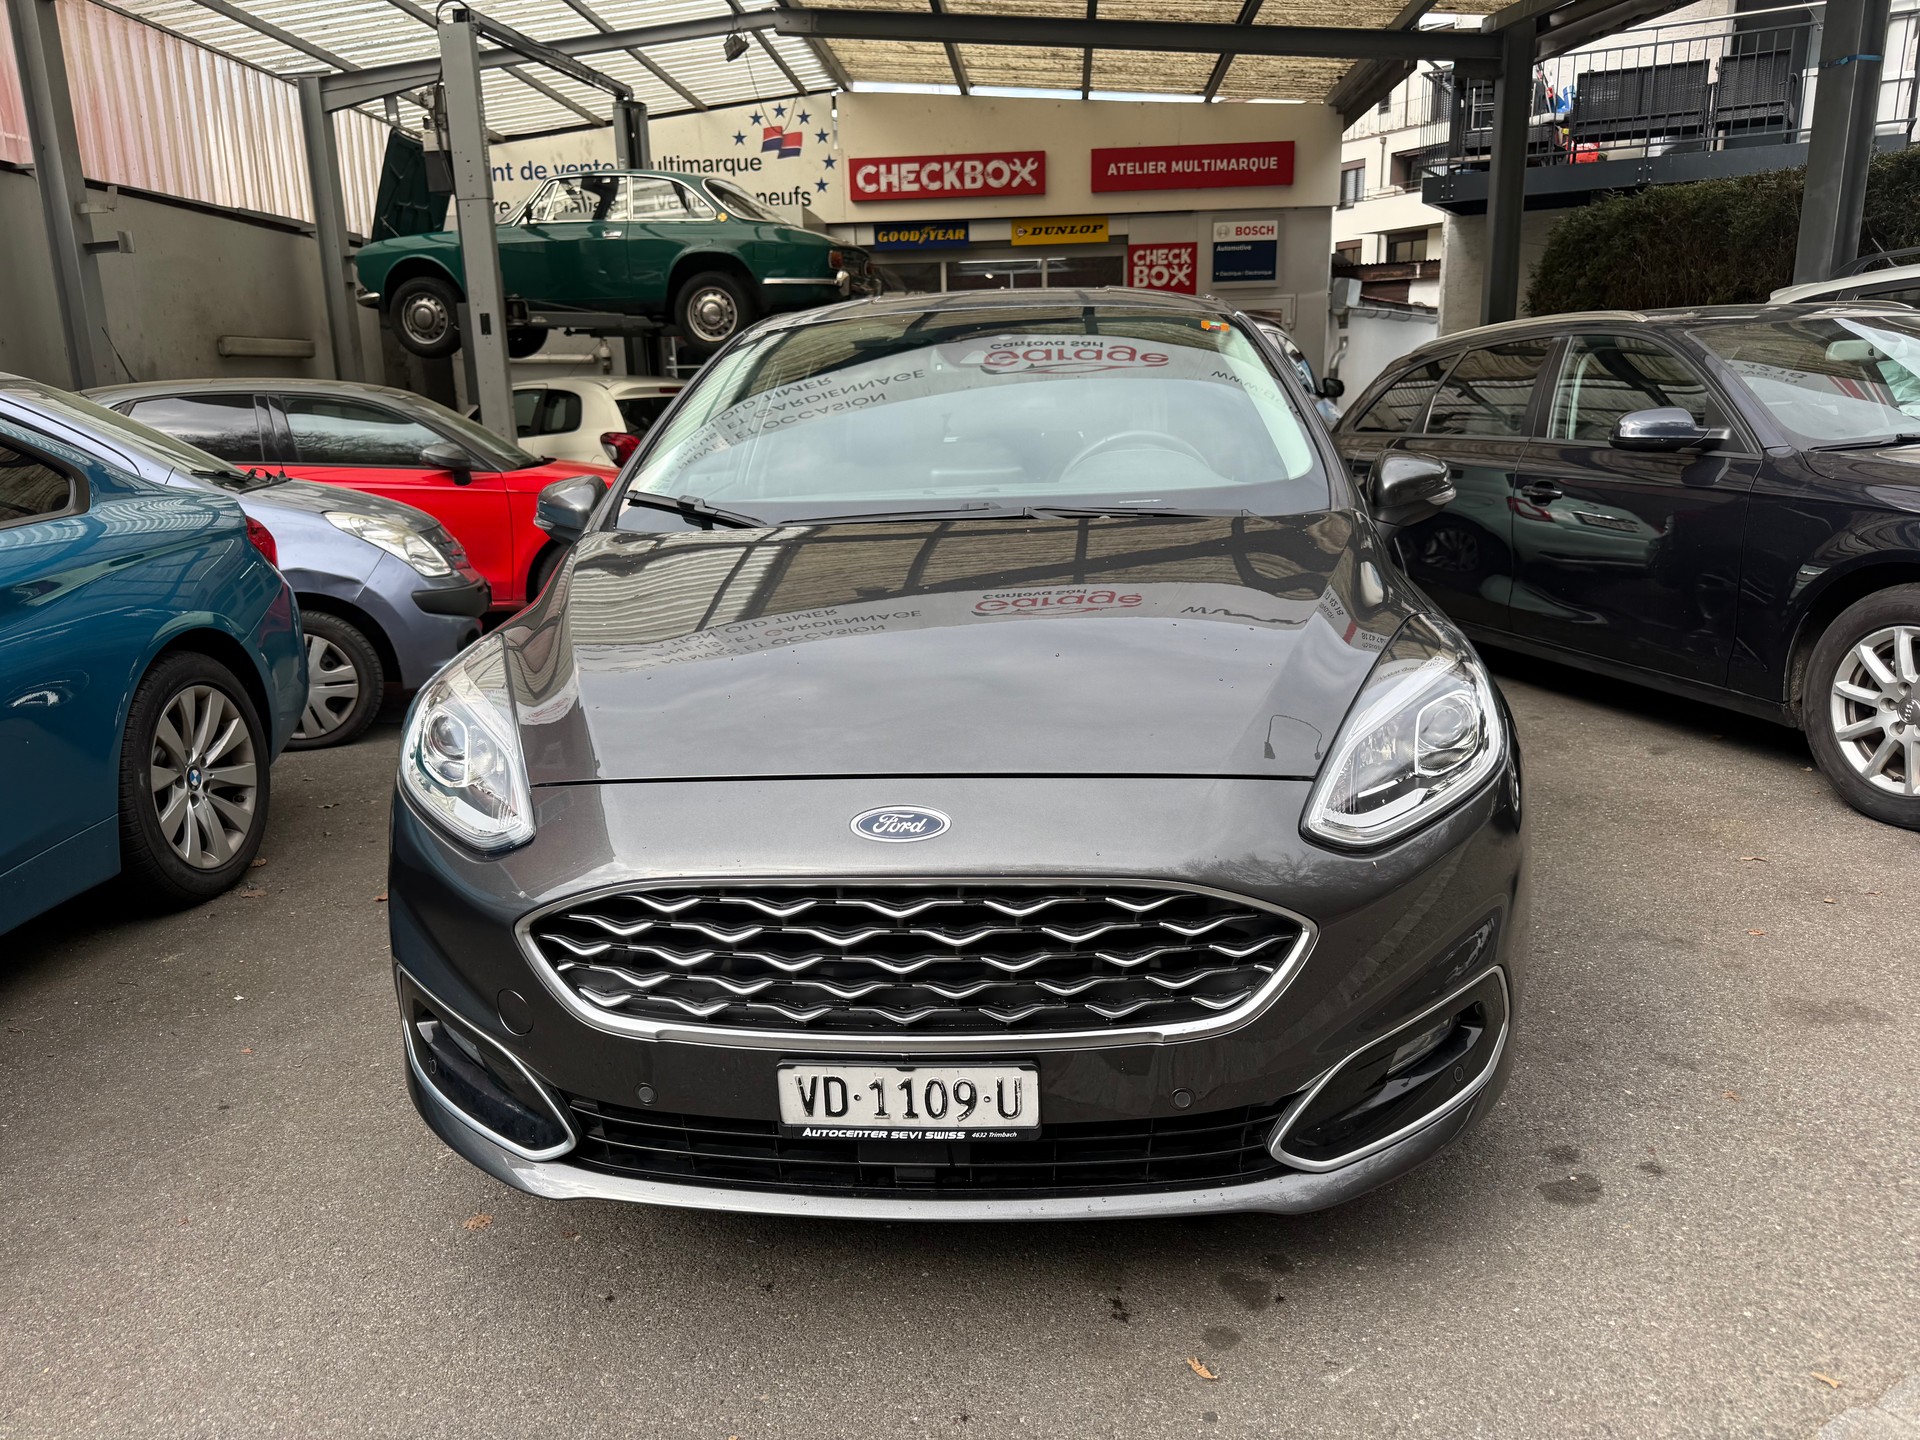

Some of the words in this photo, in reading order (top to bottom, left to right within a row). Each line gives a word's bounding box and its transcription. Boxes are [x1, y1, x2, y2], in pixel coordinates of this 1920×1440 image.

[520, 160, 547, 180] de
[856, 157, 1039, 193] CHECKBOX
[1107, 159, 1167, 176] ATELIER
[1171, 157, 1278, 173] MULTIMARQUE
[756, 186, 812, 207] neufs
[878, 227, 966, 243] GOODYEAR
[1031, 224, 1104, 237] DUNLOP
[1235, 226, 1275, 236] BOSCH
[1133, 248, 1192, 266] CHECK
[1216, 244, 1252, 252] Automotive
[1133, 265, 1192, 287] BOX
[873, 813, 926, 834] Ford
[802, 1128, 887, 1139] AUTOCENTER
[891, 1131, 922, 1139] SEVI
[925, 1131, 966, 1140] SWISS
